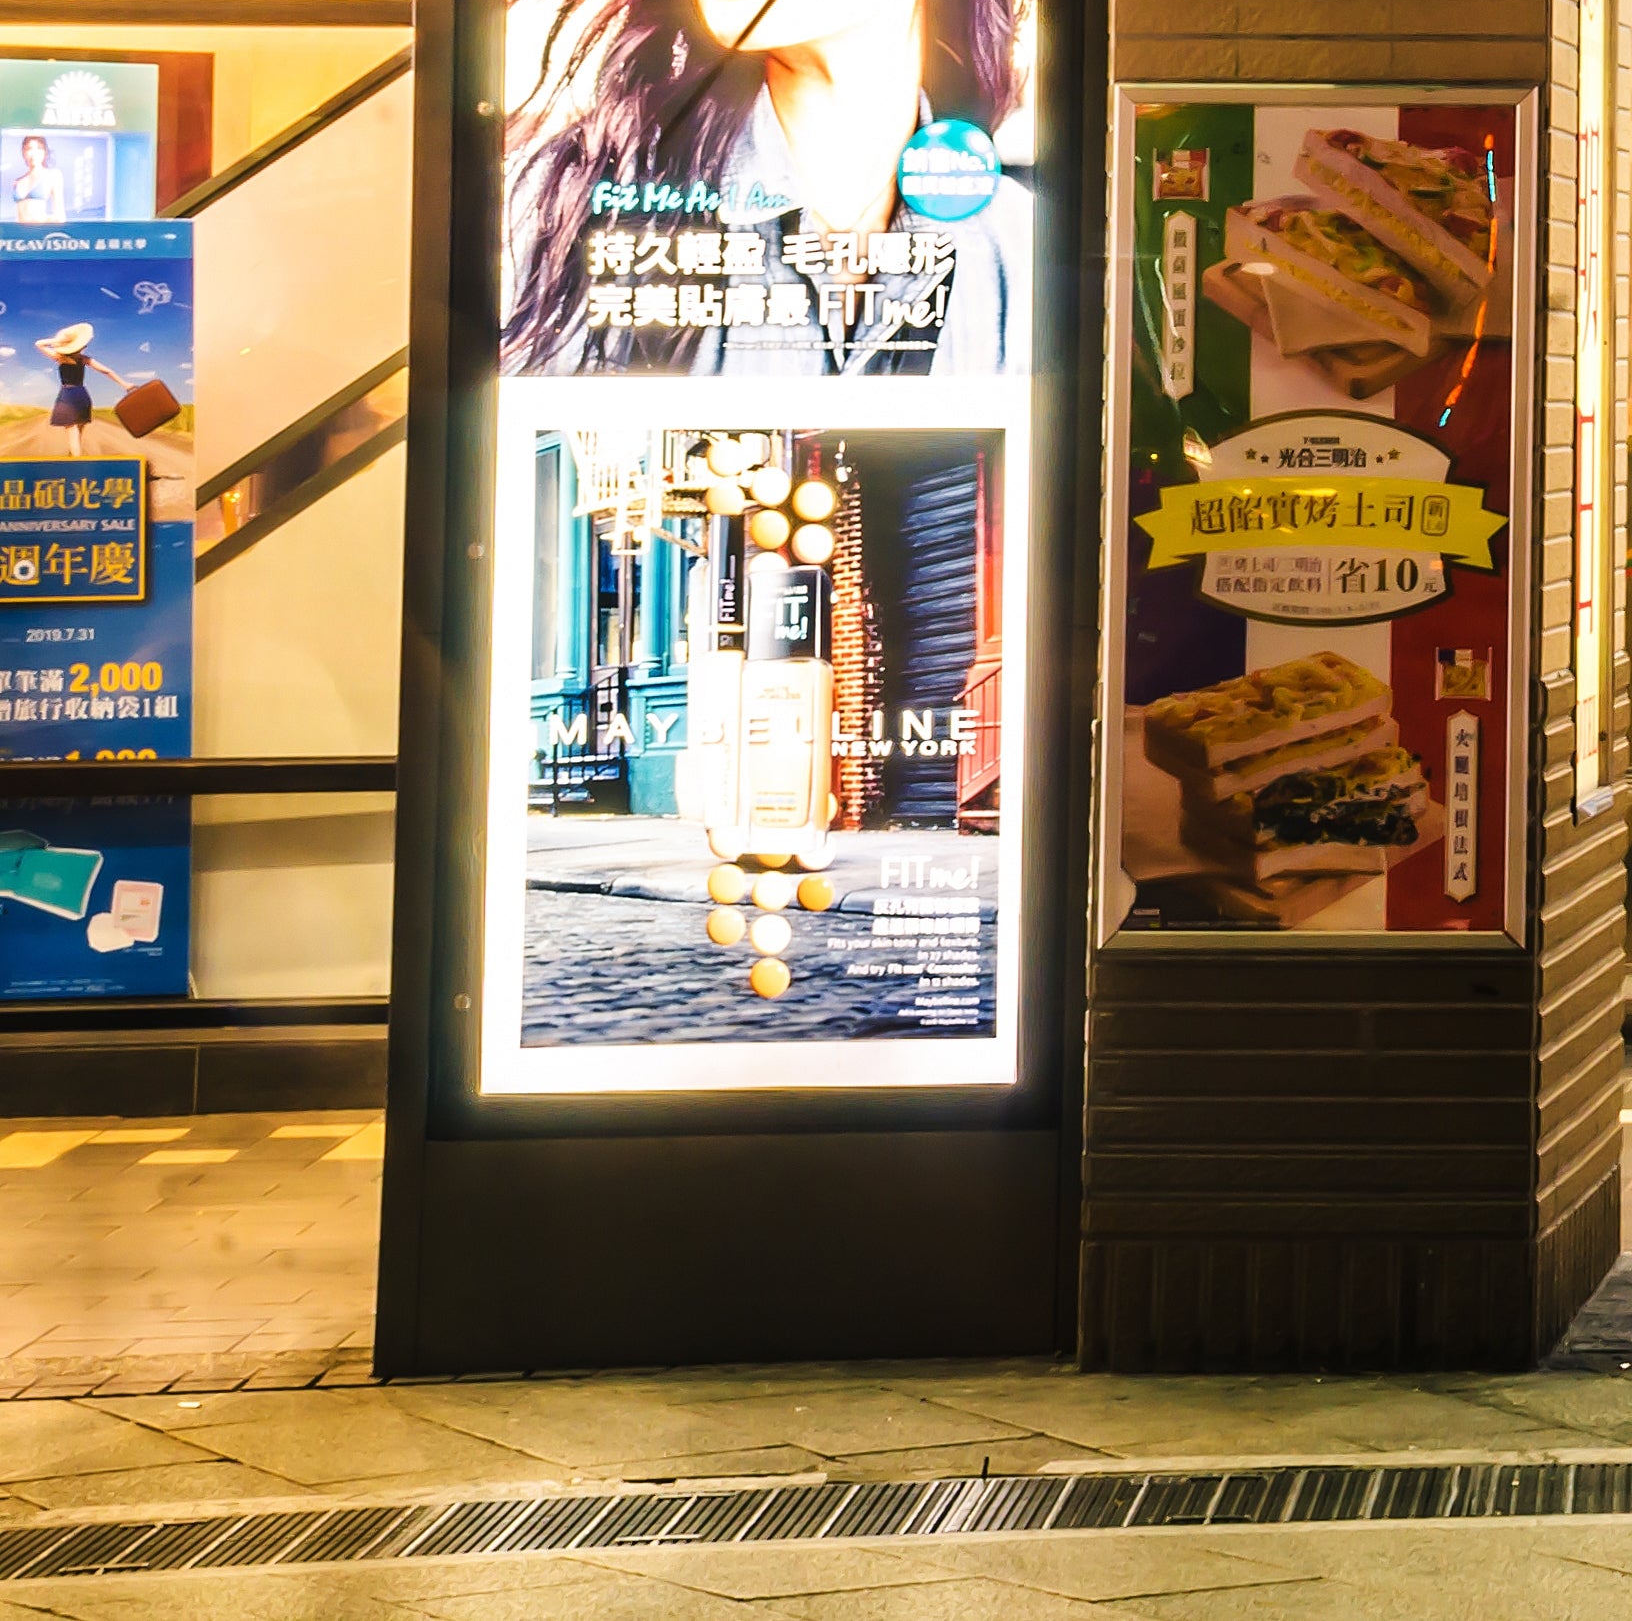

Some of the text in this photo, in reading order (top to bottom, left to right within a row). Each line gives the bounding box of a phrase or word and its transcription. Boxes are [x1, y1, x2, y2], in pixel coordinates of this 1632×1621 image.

[587, 229, 956, 277] 持久輕盈 毛孔隱形
[586, 282, 811, 328] 完美貼膚最
[1277, 448, 1368, 469] 光合三明治
[101, 518, 136, 531] SALE
[68, 661, 163, 698] 2,000
[831, 739, 978, 757] NEW YORK
